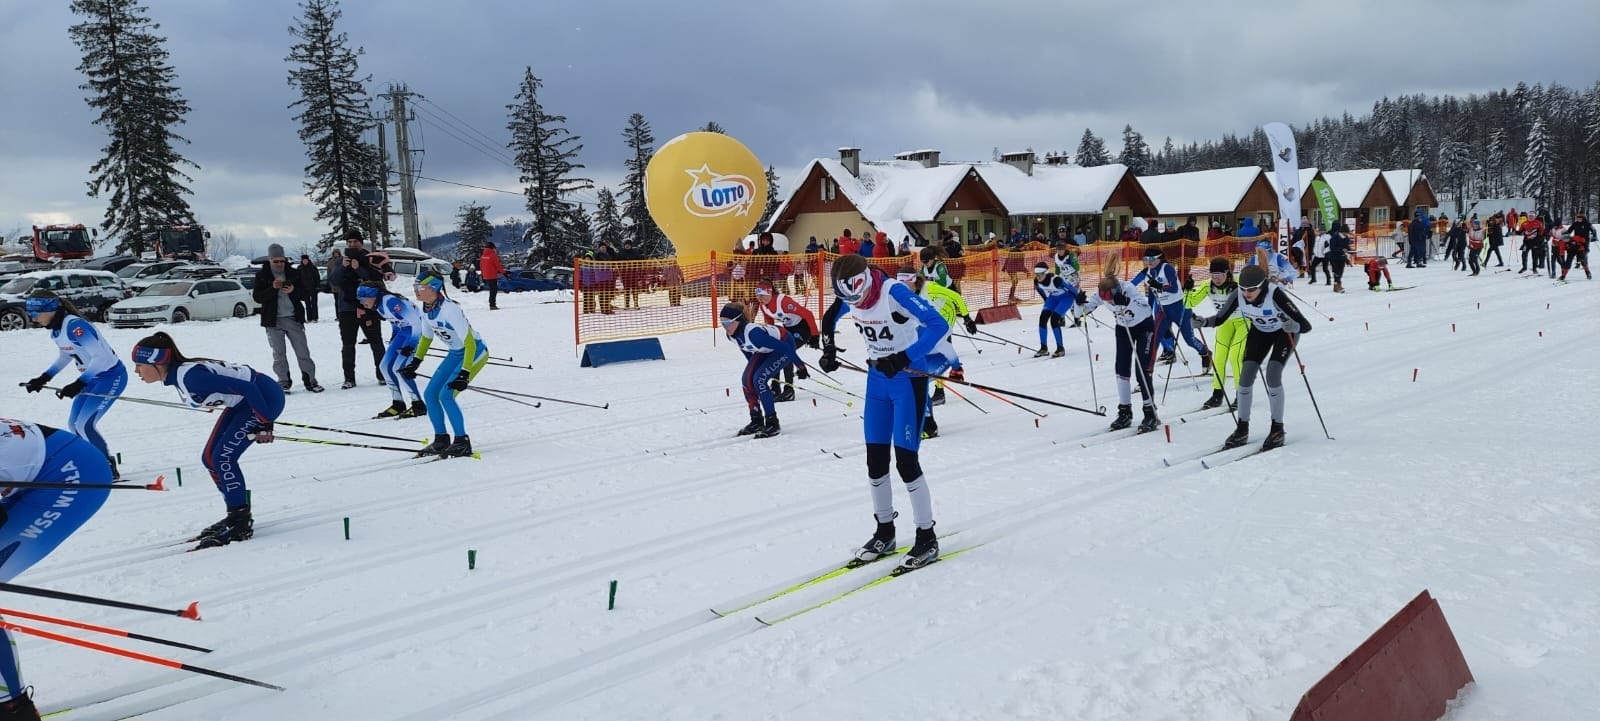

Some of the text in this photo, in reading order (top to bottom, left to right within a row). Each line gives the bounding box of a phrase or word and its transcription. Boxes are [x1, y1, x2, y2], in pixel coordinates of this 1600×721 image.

[701, 185, 744, 207] LOTTO
[1280, 234, 1288, 257] ART
[228, 415, 260, 446] LOMN
[20, 510, 62, 539] WSS
